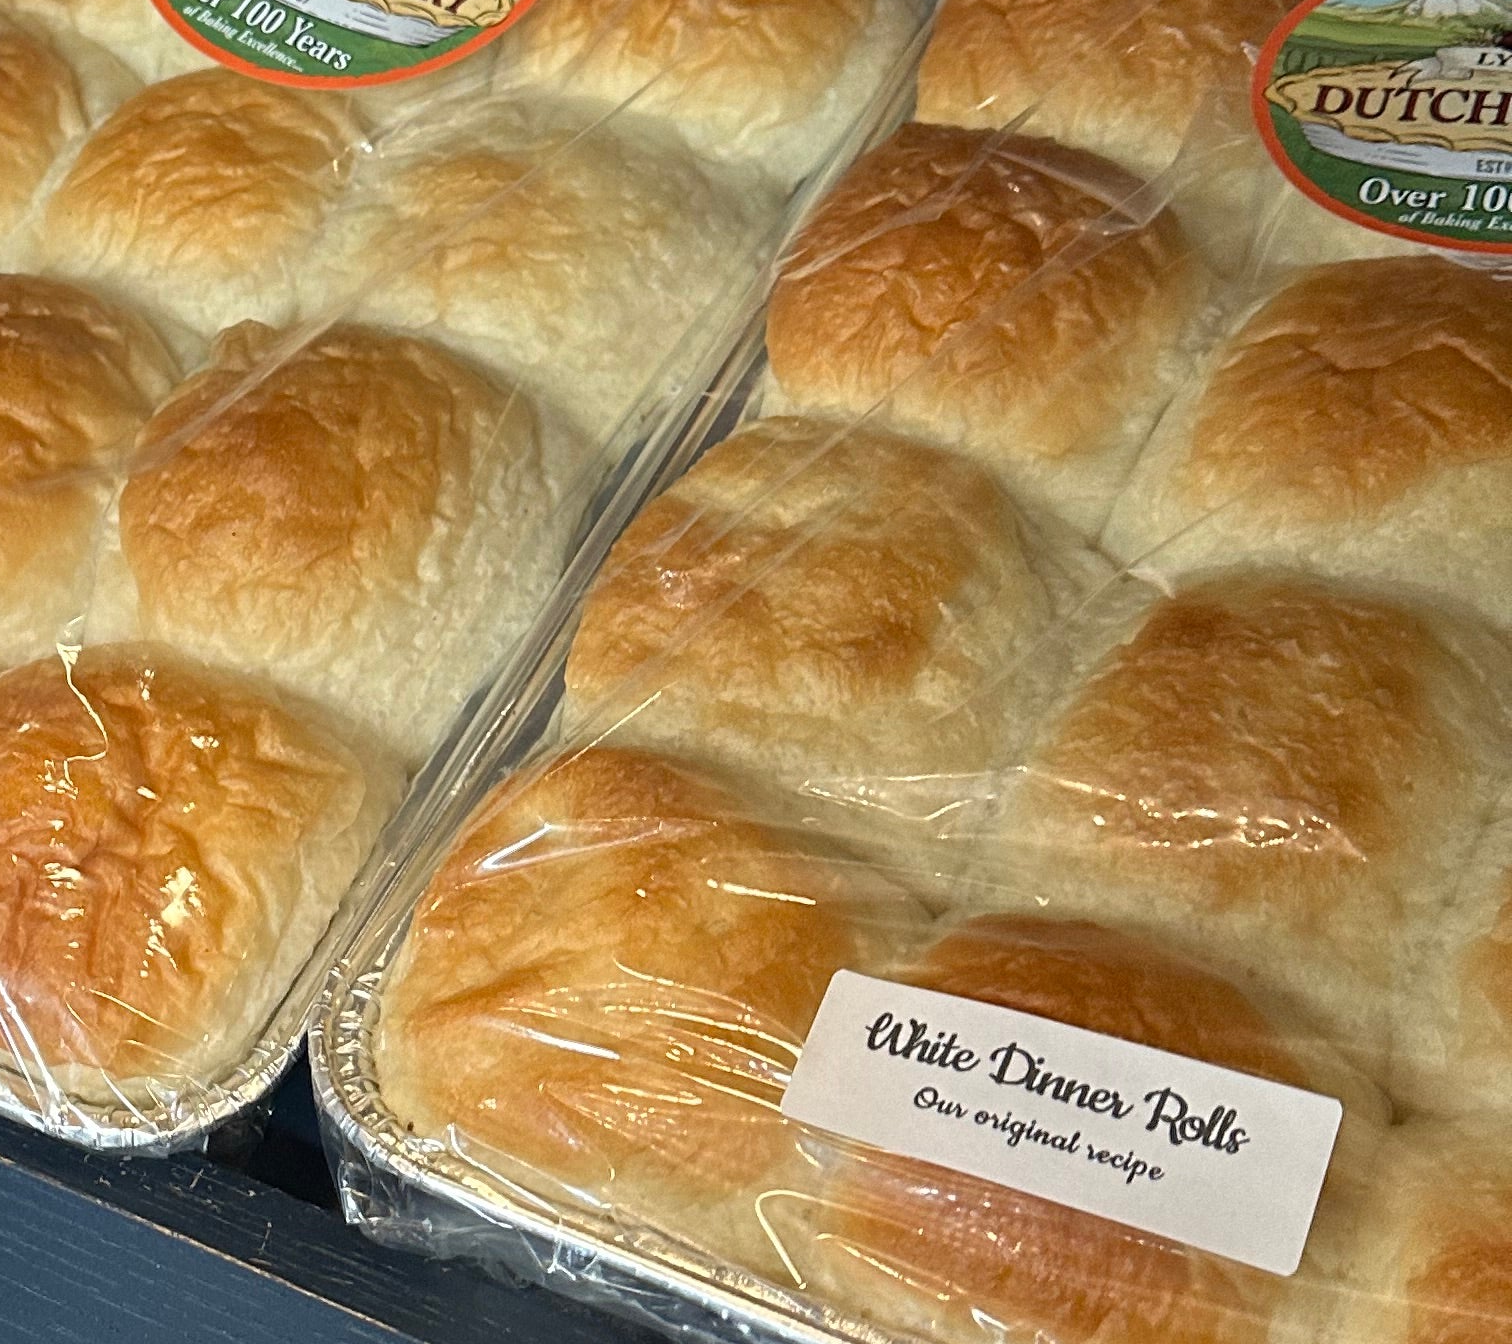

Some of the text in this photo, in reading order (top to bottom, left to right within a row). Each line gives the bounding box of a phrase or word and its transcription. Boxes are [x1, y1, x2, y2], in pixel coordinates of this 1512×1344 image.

[285, 16, 352, 70] Years
[1313, 84, 1512, 126] DUTCH
[1359, 177, 1512, 212] Over 10
[1398, 211, 1419, 223] of
[1420, 211, 1484, 231] Baking
[865, 1011, 1250, 1156] White Dinner Rolls
[913, 1086, 1166, 1184] Our original recipe
